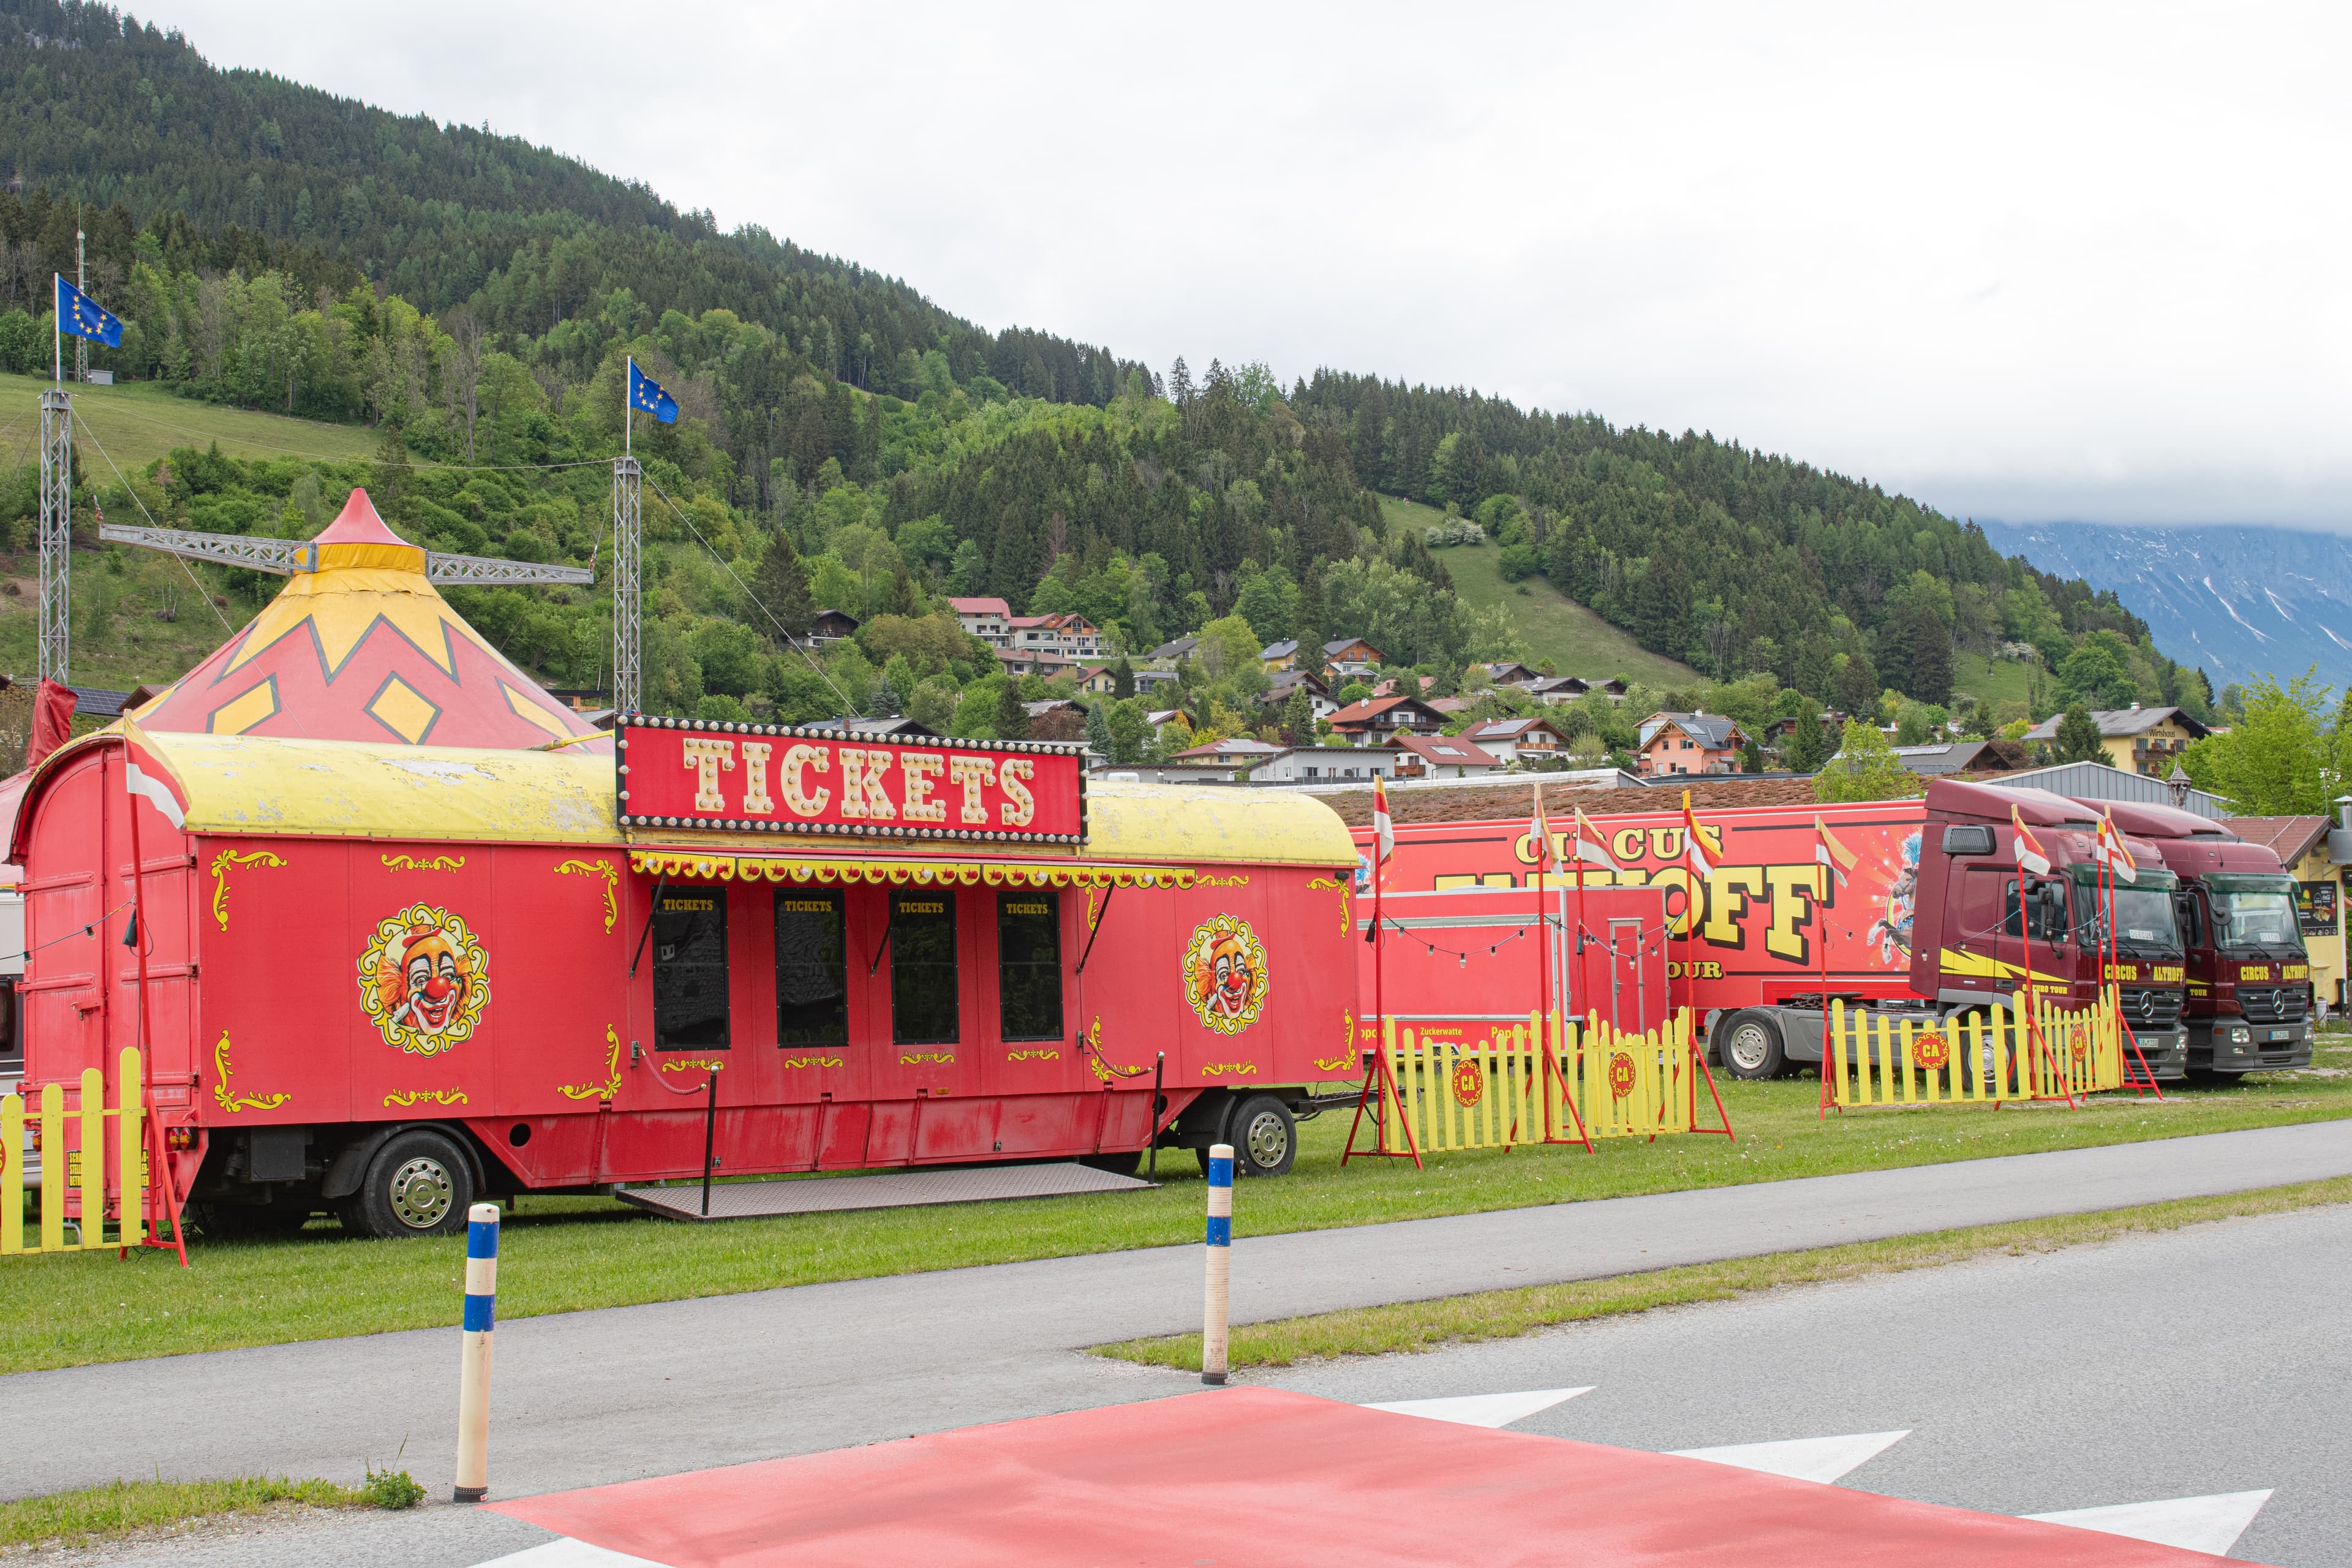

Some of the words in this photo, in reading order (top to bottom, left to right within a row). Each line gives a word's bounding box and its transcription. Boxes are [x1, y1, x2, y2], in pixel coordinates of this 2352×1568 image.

[2149, 728, 2176, 737] Wirtshaus
[683, 737, 1035, 827] TICKETS
[1514, 824, 1724, 865] CICU
[663, 899, 713, 911] TICKETS
[785, 901, 832, 912] TICKETS
[899, 902, 944, 913] TICKETS
[1006, 903, 1048, 914] TICKETS
[1667, 960, 1724, 980] OUR
[2153, 966, 2184, 982] ALTHOFF
[2240, 966, 2269, 981] CIRCUS
[2282, 965, 2309, 980] ALTHOFF
[2032, 984, 2049, 993] EURO
[2050, 986, 2068, 995] TOUR
[1420, 1027, 1463, 1036] Zuckerwatte
[1491, 1026, 1532, 1042] Popr
[2075, 1036, 2083, 1049] CA
[1922, 1044, 1940, 1058] CA
[1616, 1066, 1629, 1082] CA
[1461, 1075, 1476, 1091] CA
